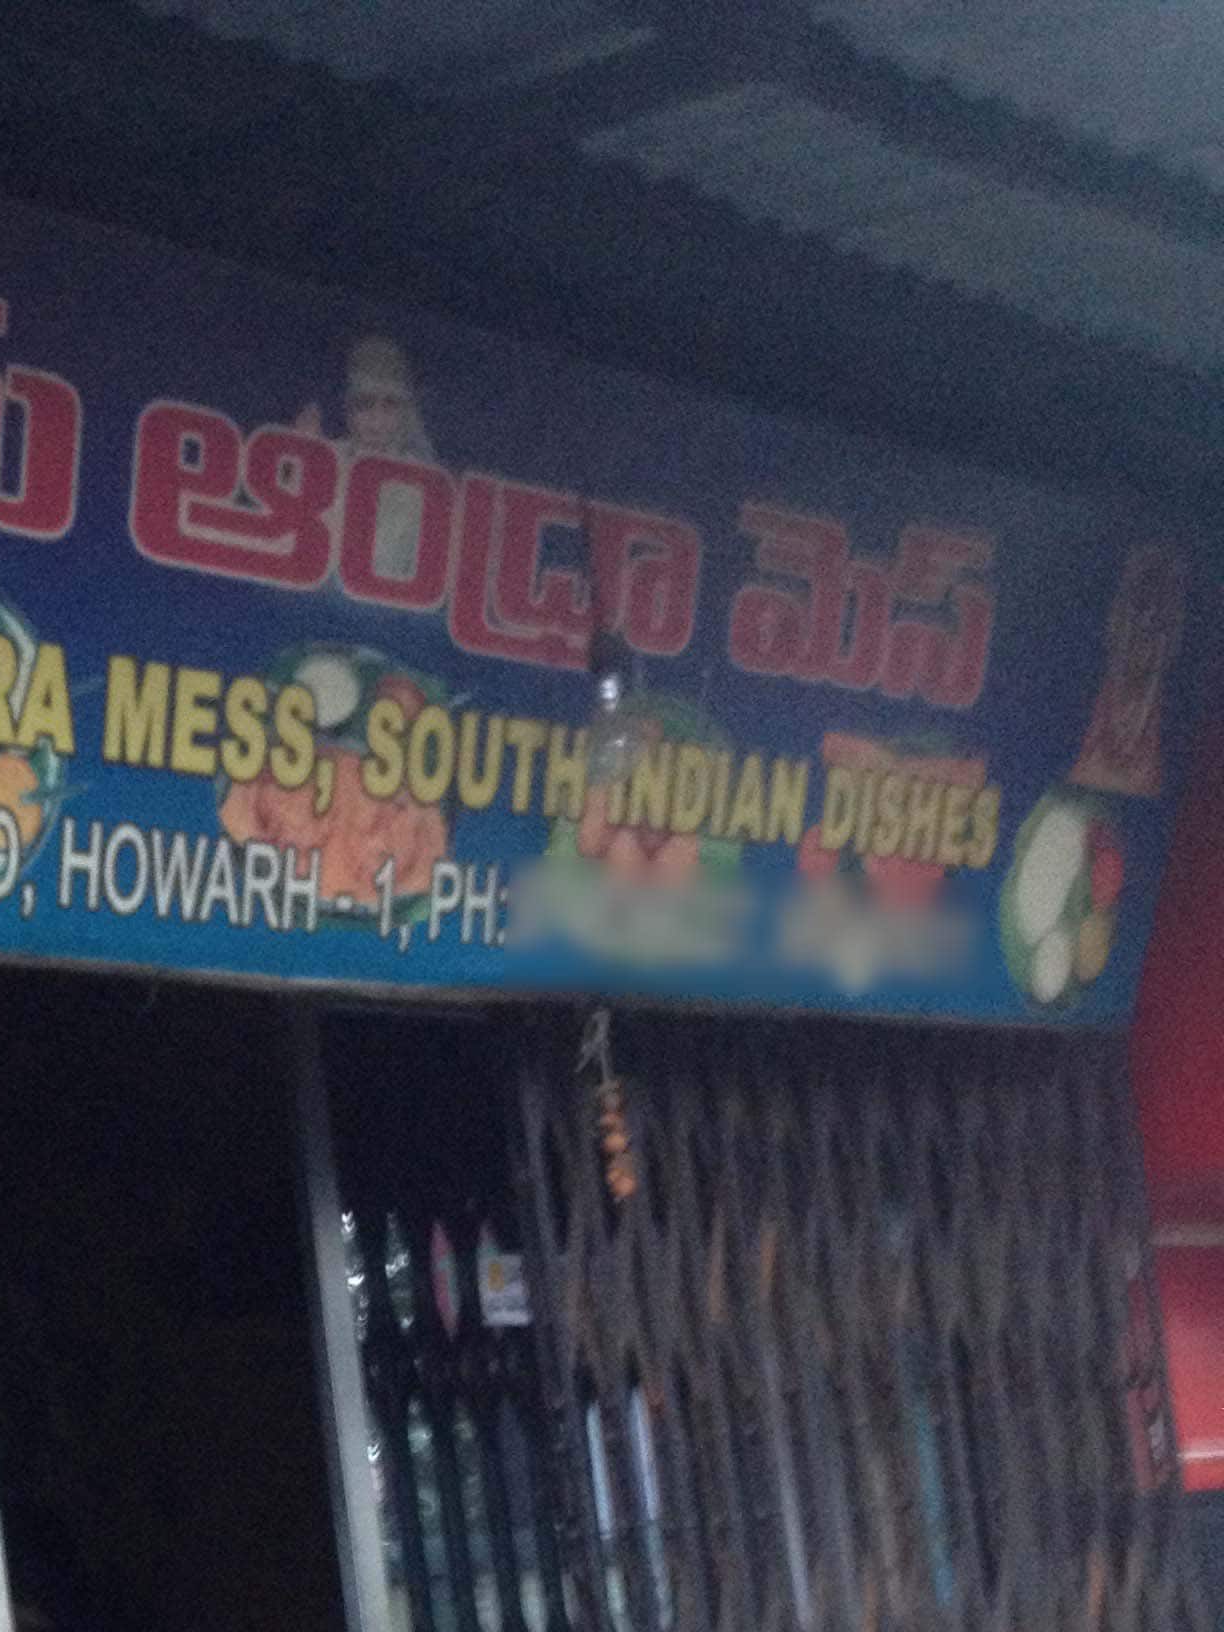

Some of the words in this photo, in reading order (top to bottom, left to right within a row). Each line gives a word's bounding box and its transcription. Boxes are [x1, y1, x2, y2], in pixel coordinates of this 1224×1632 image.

[103, 655, 334, 814] MESS,
[362, 698, 588, 822] SOUTH
[606, 738, 810, 845] INDIAN
[820, 763, 1002, 869] DISHES
[59, 816, 321, 933] HOWARH
